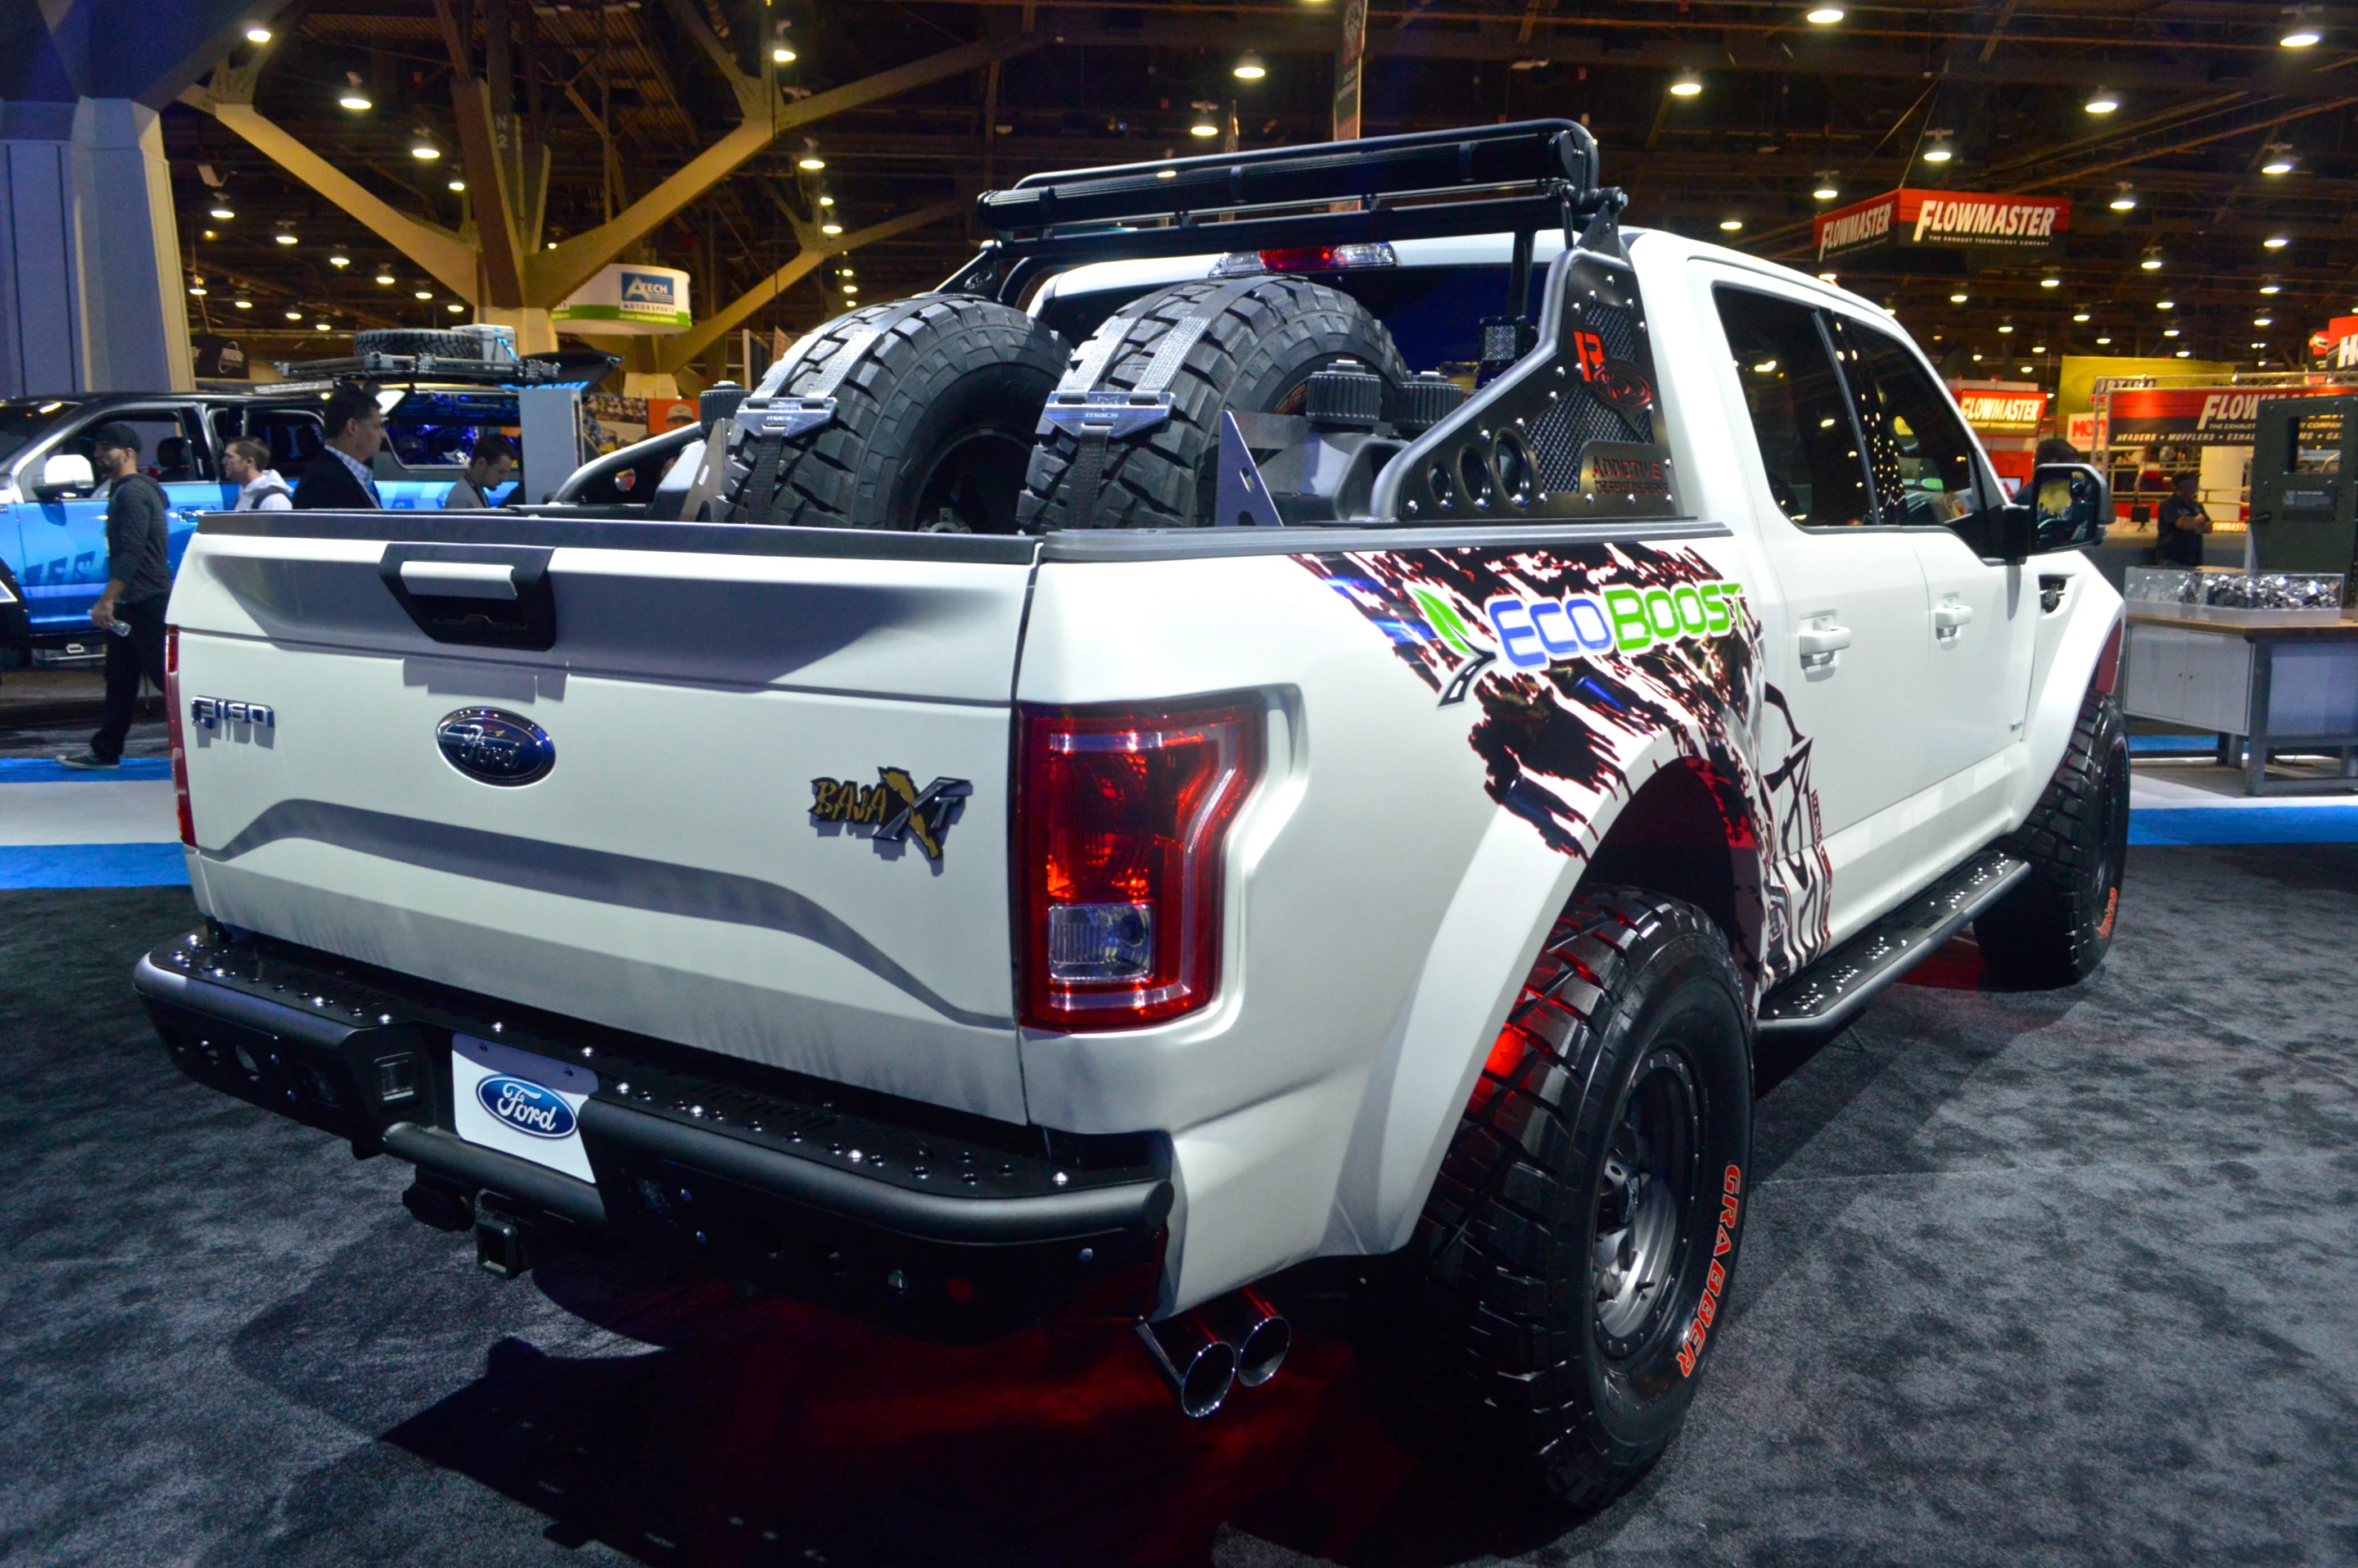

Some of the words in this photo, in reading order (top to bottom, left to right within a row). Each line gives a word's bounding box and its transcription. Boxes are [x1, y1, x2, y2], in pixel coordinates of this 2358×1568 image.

[1818, 204, 1891, 263] FLOWMASTER
[1913, 200, 2056, 242] FLOWMASTER
[1944, 235, 1972, 243] EXHAUST
[1975, 237, 2017, 246] TECHNOLOGY
[1961, 397, 2040, 421] FLOWMASTER
[2116, 433, 2157, 441] HEADERS
[2168, 433, 2215, 441] MUFFLERS
[497, 1082, 558, 1132] Ford
[1676, 1164, 1741, 1377] GRABBER
